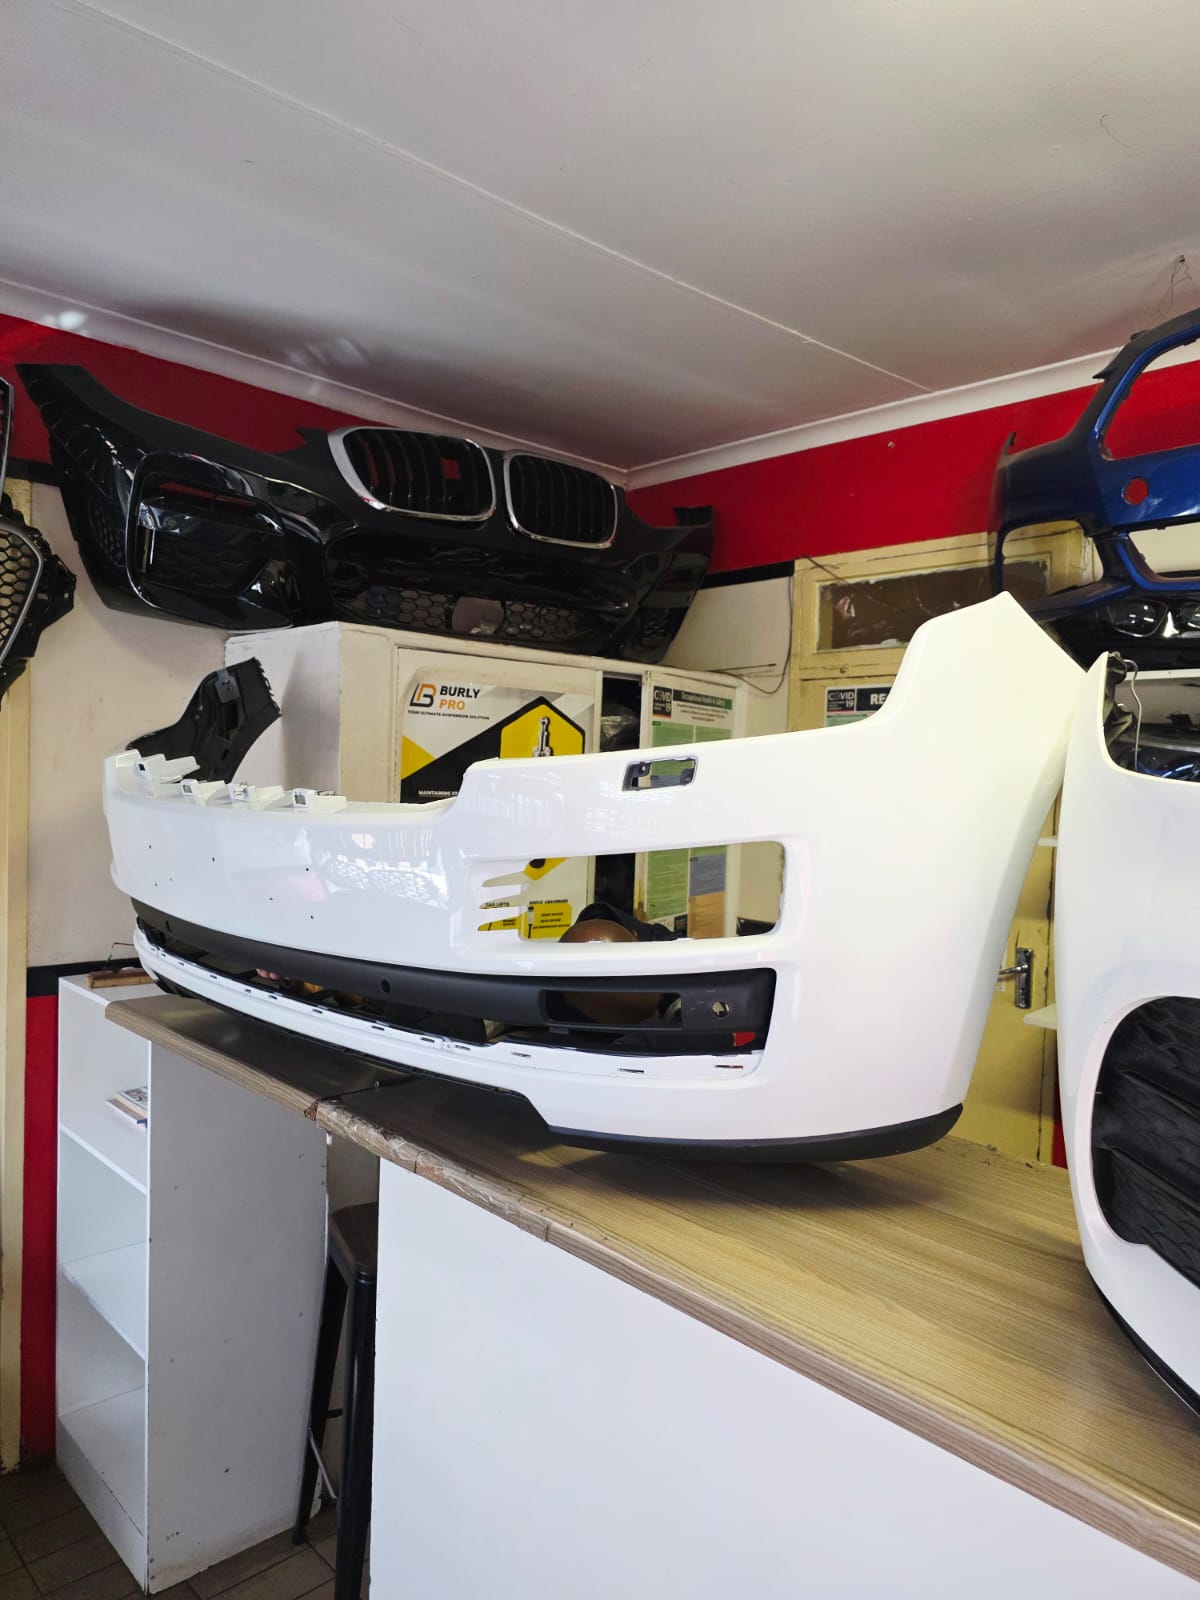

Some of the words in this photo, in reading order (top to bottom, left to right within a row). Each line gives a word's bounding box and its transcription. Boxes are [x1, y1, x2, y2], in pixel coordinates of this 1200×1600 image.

[440, 685, 480, 698] BURLY
[828, 691, 855, 700] COVID
[439, 699, 465, 710] PRO
[845, 700, 854, 708] 19
